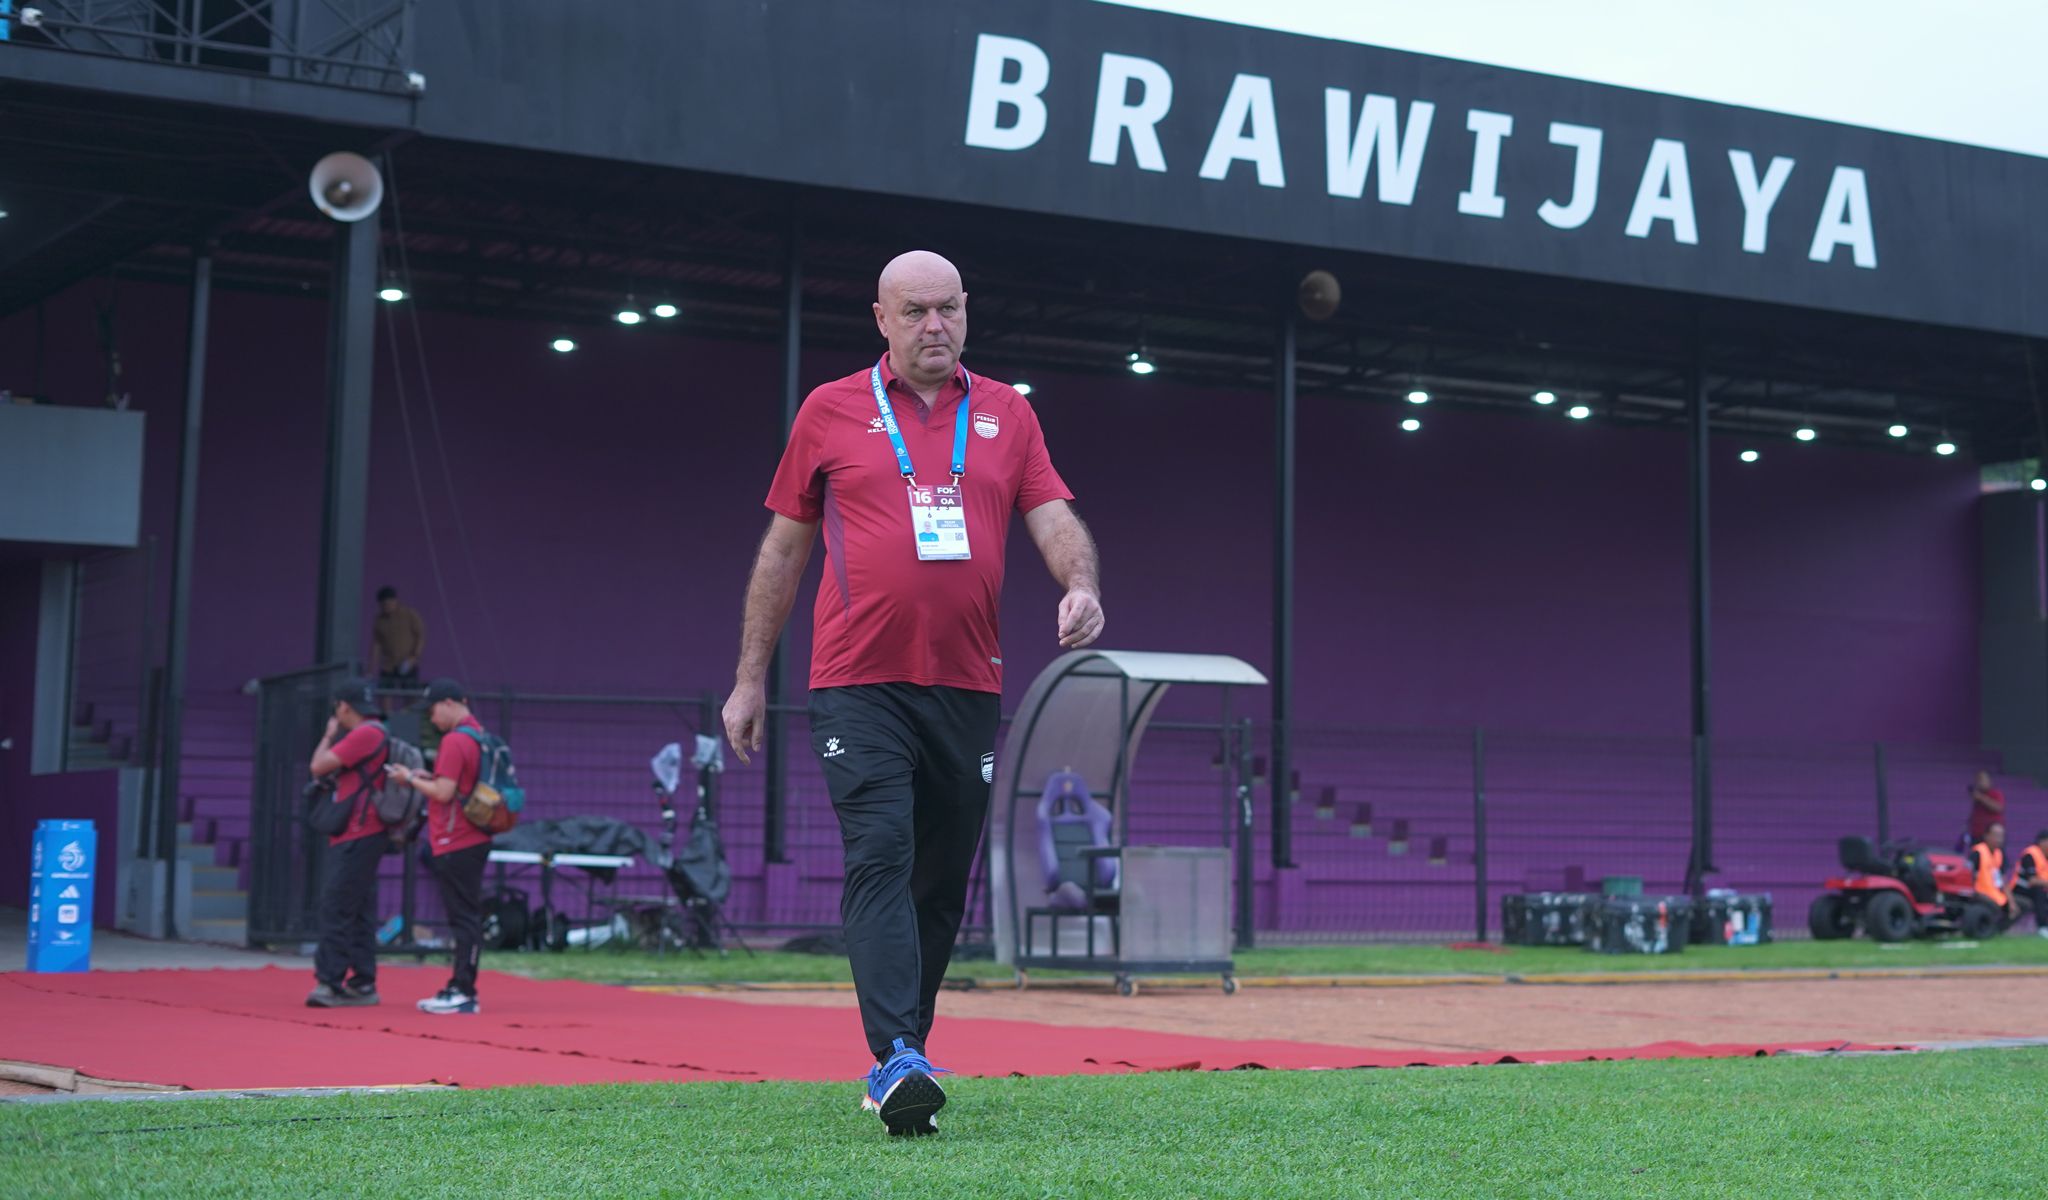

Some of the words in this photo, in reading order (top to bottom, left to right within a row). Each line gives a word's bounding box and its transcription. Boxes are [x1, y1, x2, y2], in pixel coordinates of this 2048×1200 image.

[964, 33, 1878, 269] BRAWIJAYA
[875, 389, 891, 414] SUPER
[976, 415, 996, 423] PERSIB
[913, 491, 932, 504] 16
[823, 749, 845, 757] KELME
